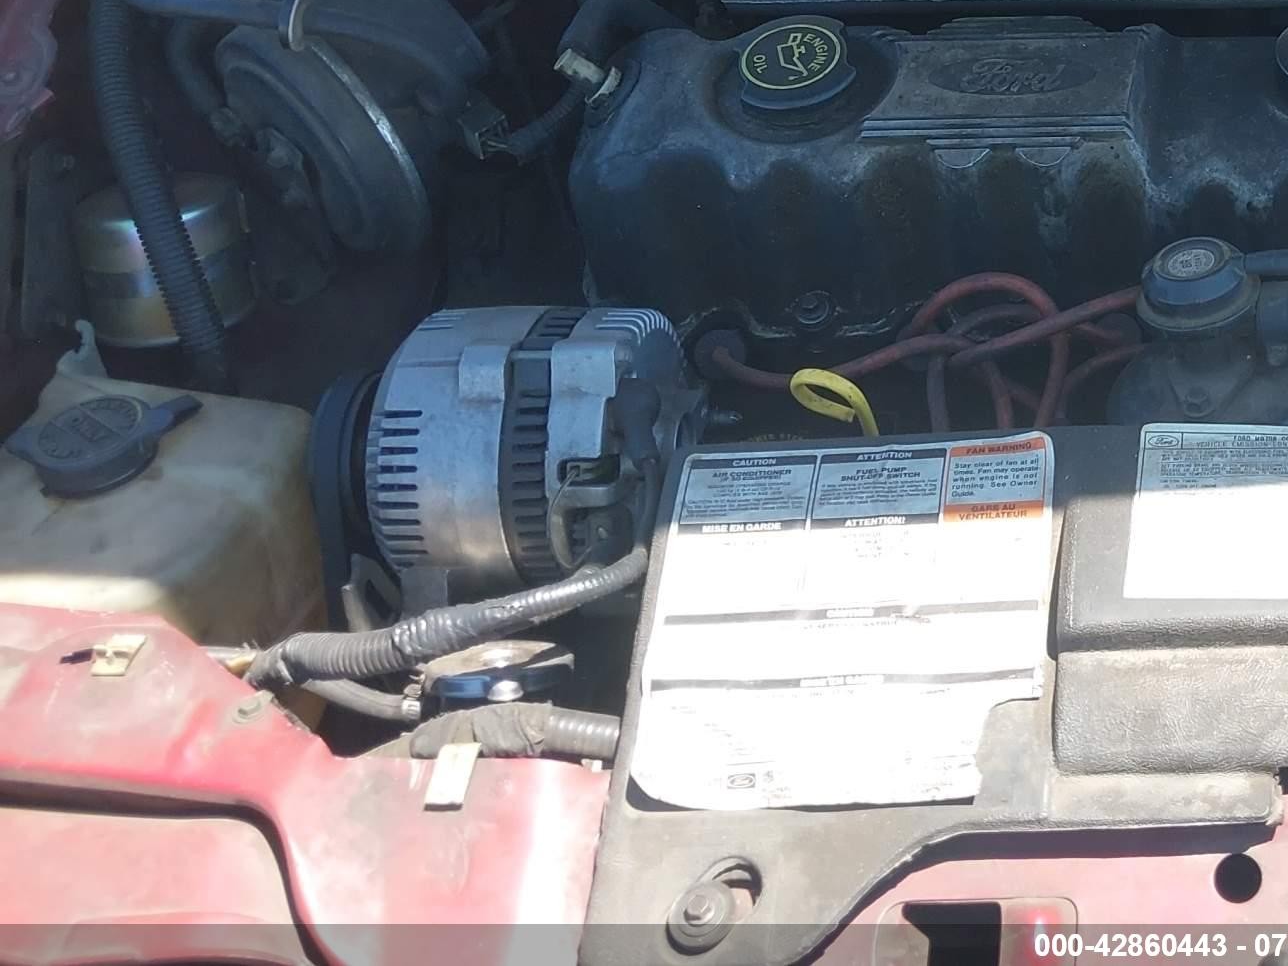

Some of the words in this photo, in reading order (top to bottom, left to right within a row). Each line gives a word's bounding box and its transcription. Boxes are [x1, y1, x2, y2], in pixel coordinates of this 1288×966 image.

[803, 33, 829, 72] ENGINE
[753, 54, 768, 74] OIL
[958, 57, 1068, 94] Ford
[988, 442, 1032, 453] WARNING
[856, 452, 912, 460] ATTENTION
[732, 458, 777, 467] CAUTION
[959, 510, 1027, 521] VENTILATEUR
[844, 516, 906, 527] ATTENTION!
[702, 524, 728, 533] MISE
[730, 524, 744, 532] EN
[746, 522, 782, 530] GARDE
